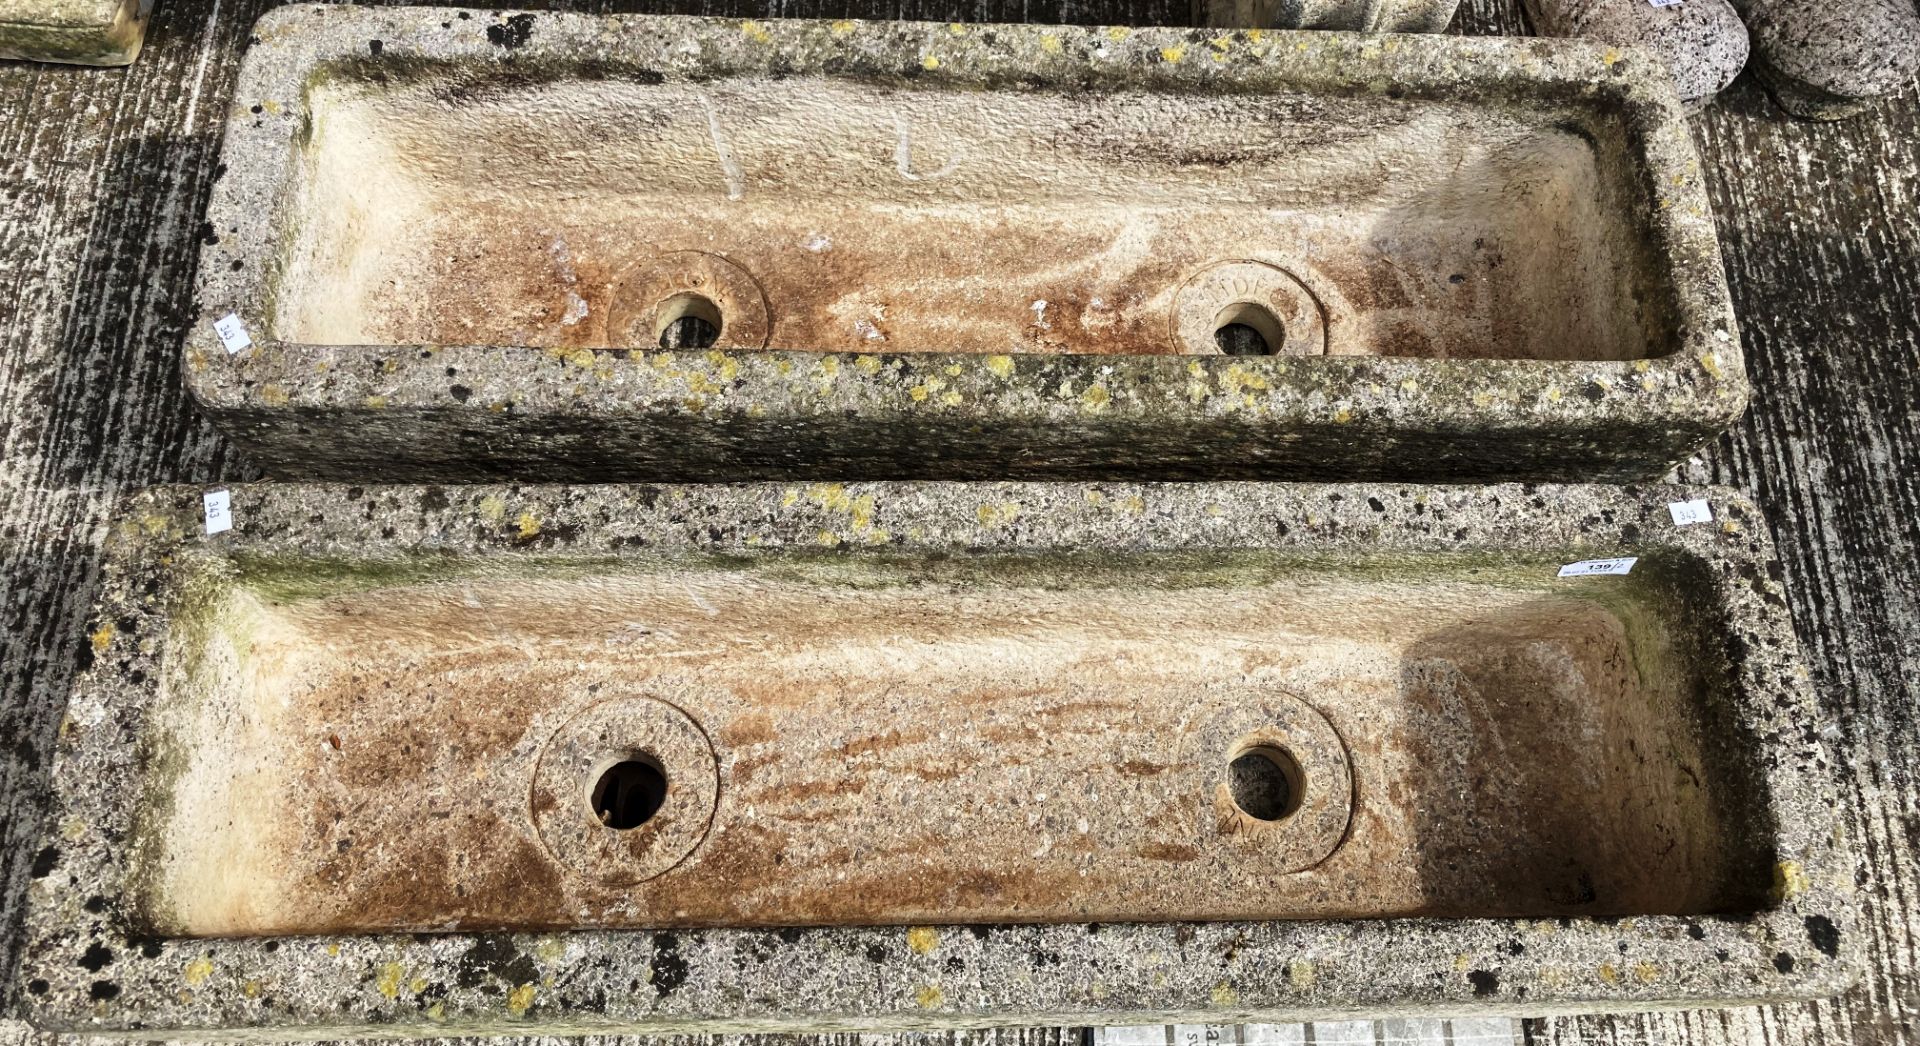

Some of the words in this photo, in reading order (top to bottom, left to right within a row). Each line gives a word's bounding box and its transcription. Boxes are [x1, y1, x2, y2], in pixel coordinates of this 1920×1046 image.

[220, 324, 235, 340] 343
[208, 501, 219, 519] 343
[1679, 509, 1697, 520] 343
